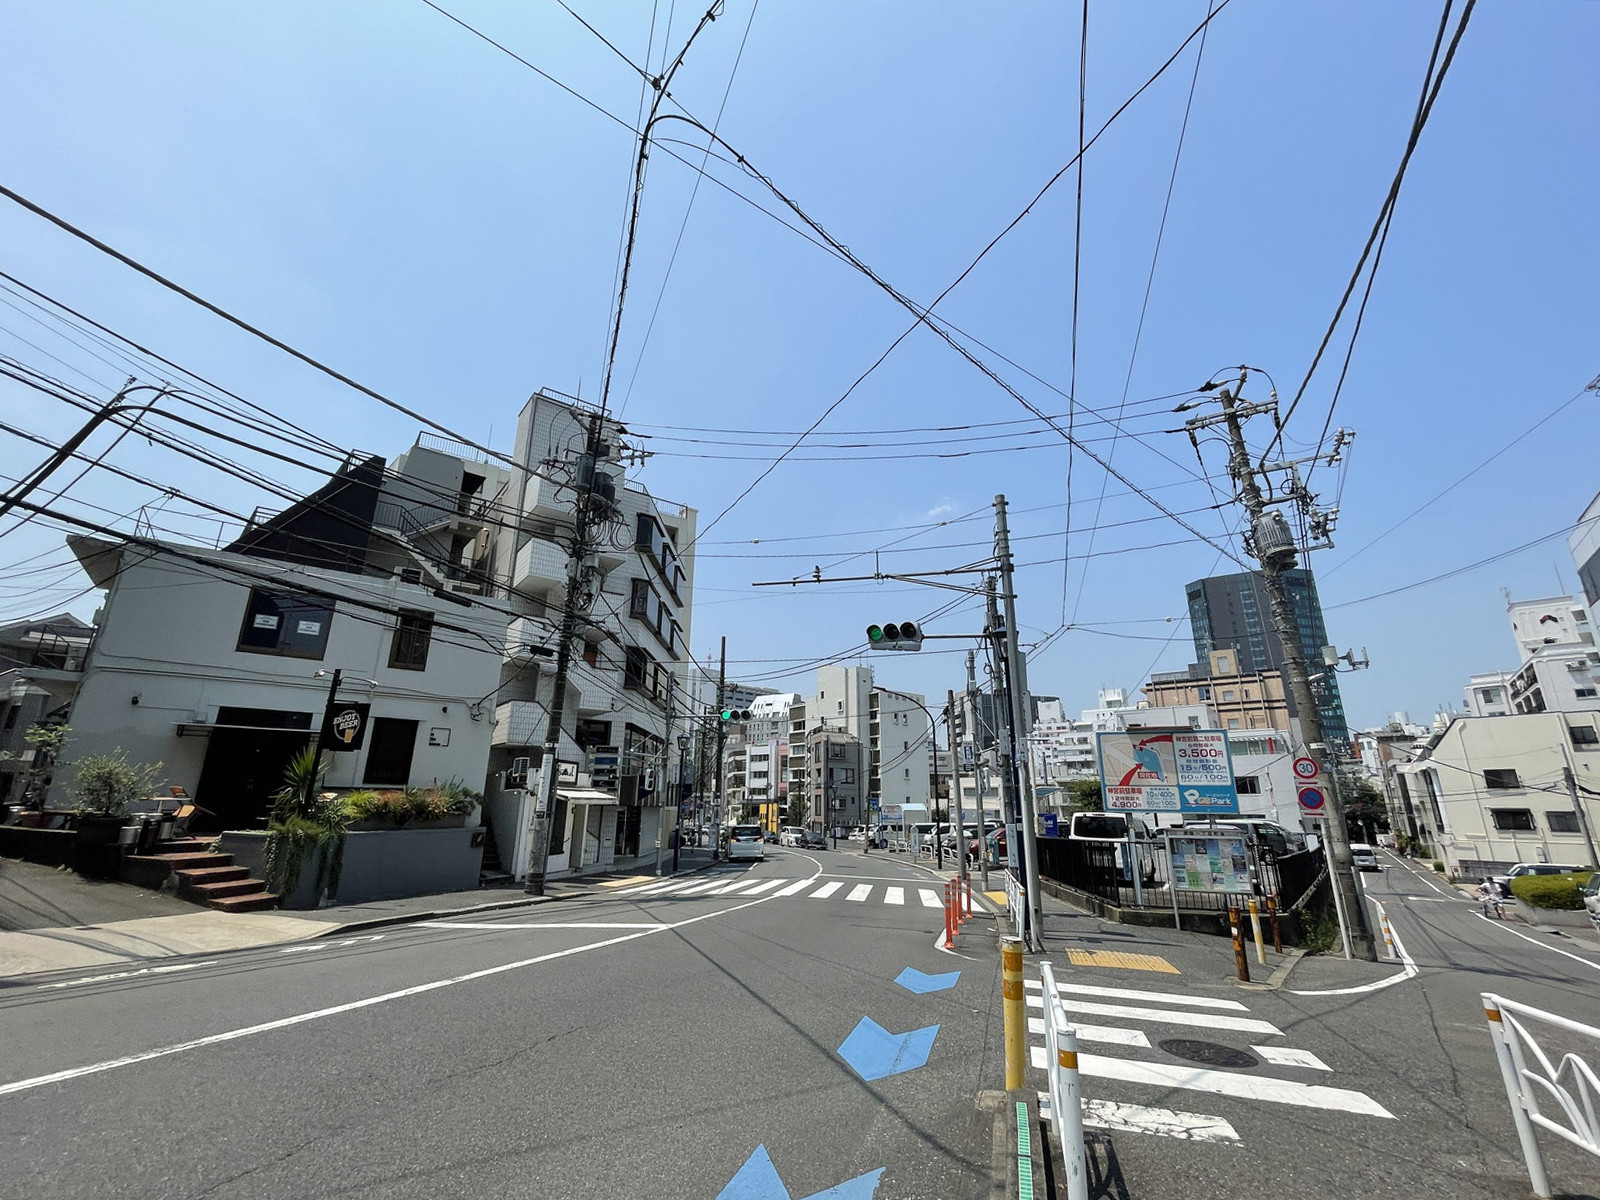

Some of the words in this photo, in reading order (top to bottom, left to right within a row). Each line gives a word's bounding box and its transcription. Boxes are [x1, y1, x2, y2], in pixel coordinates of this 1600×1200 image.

[333, 713, 357, 725] ENJOY
[339, 720, 358, 730] BEER
[1299, 763, 1314, 773] 30
